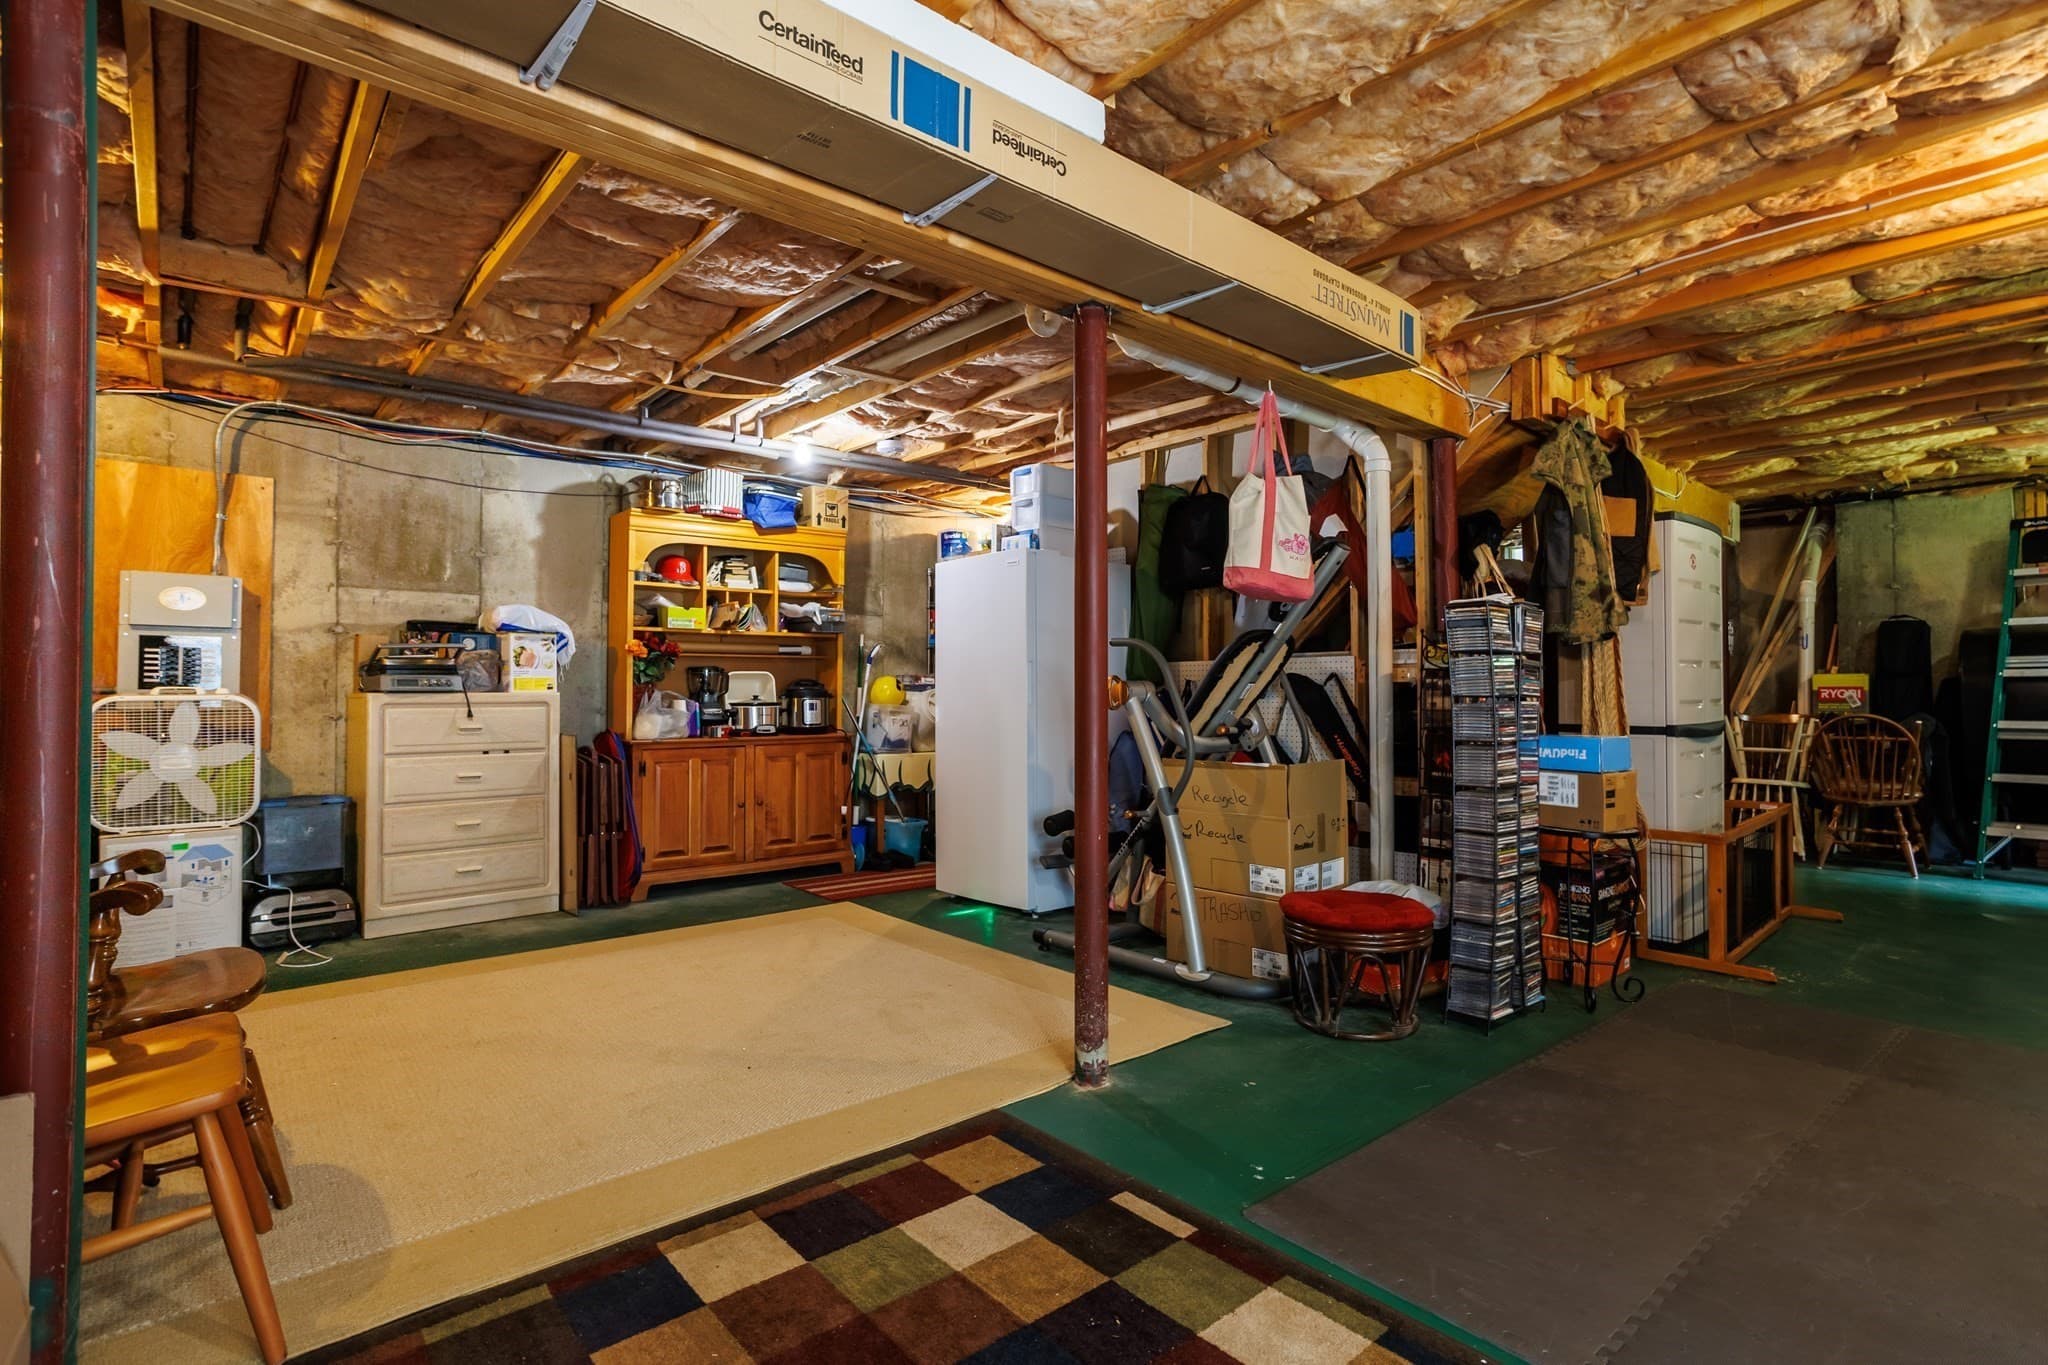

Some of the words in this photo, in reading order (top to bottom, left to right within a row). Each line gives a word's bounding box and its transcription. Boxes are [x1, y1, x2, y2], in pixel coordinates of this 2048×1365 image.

[758, 10, 863, 75] CertainTeed
[992, 128, 1066, 176] CertainTeed
[1192, 785, 1249, 808] Recycle
[1195, 819, 1248, 845] Recycle
[1200, 896, 1249, 923] TRASH
